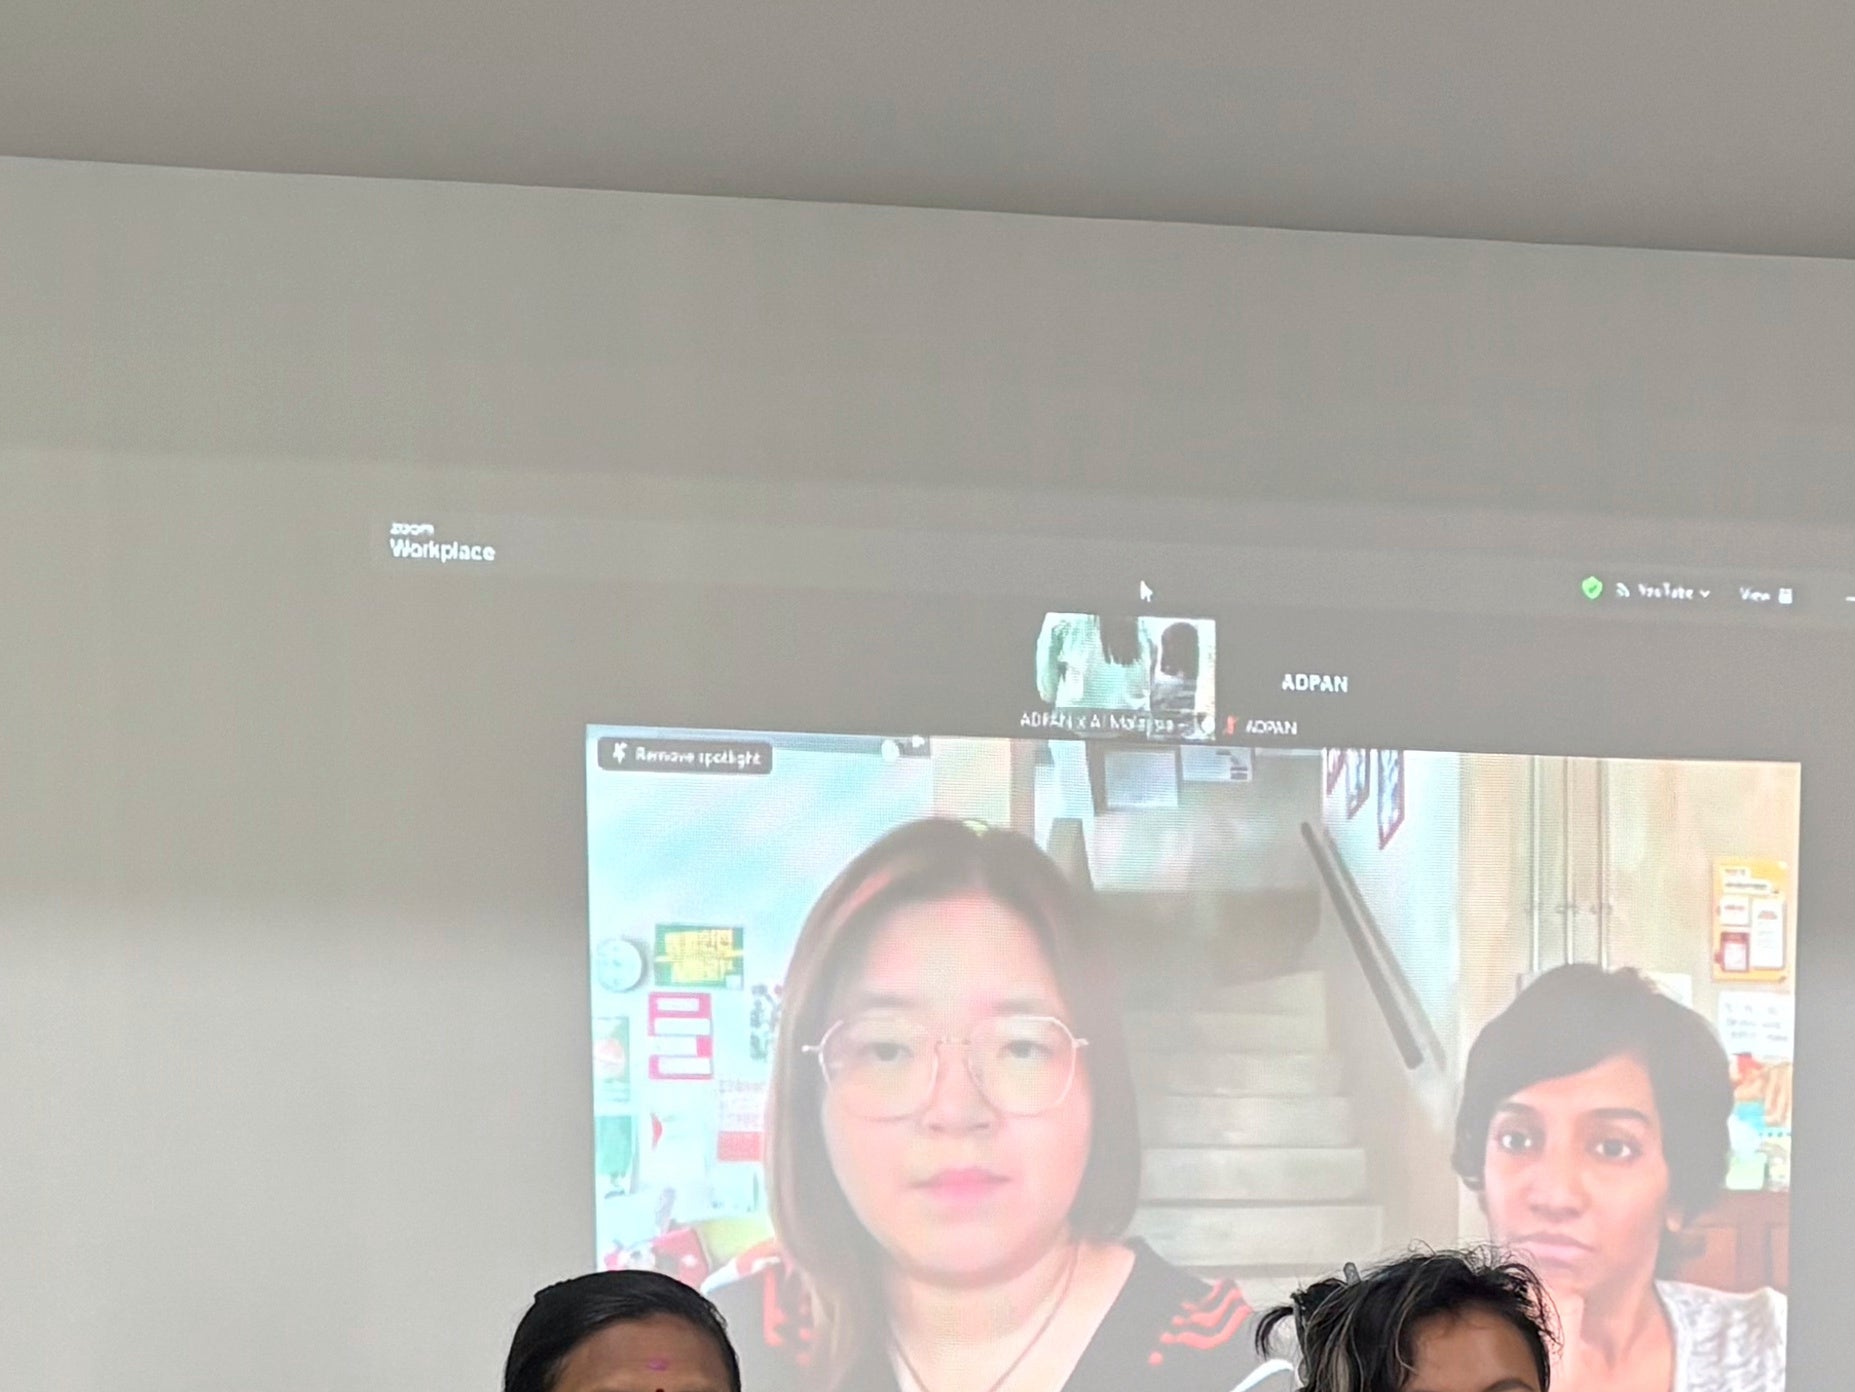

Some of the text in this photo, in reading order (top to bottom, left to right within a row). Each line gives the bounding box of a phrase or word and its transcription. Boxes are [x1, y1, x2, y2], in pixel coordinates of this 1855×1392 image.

[390, 539, 495, 563] Workplace
[1282, 674, 1347, 693] ADPAN
[1246, 719, 1297, 735] ADPAN
[635, 746, 761, 769] Remove spotlight
